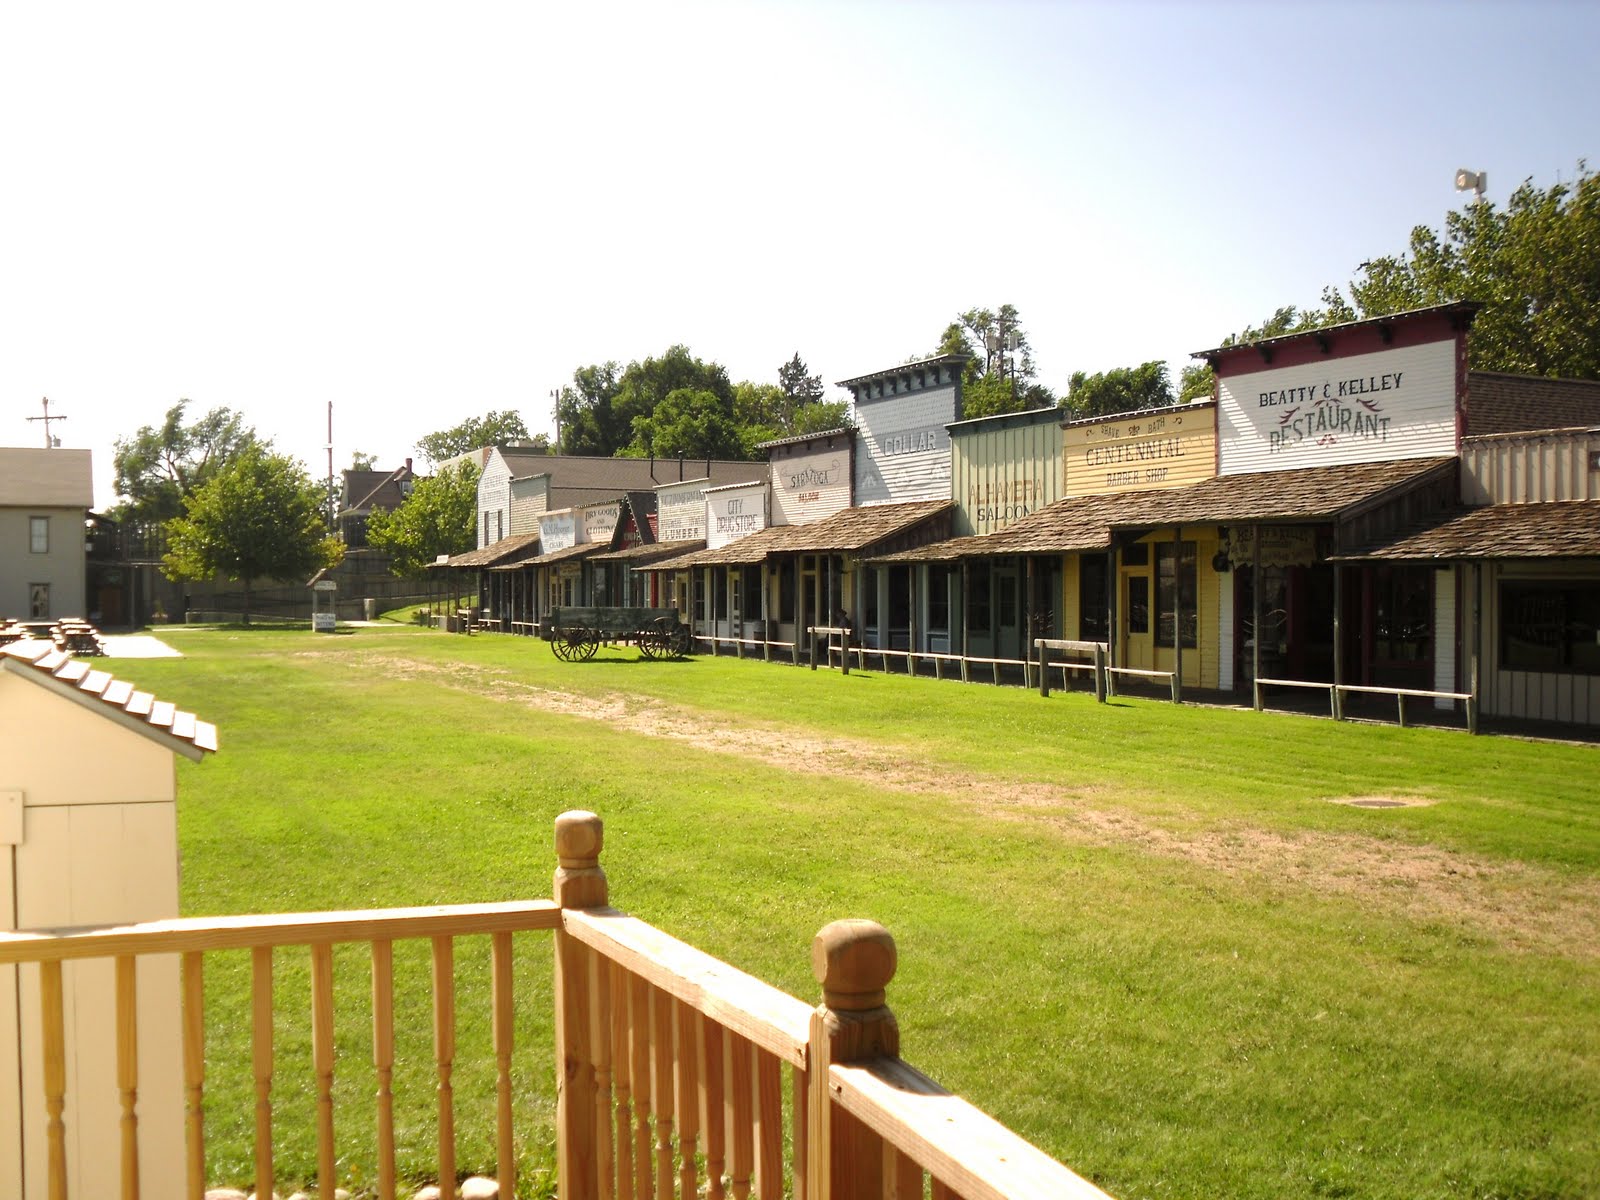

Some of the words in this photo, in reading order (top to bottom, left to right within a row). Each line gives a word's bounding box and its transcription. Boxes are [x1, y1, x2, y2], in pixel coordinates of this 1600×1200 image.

[1259, 385, 1316, 407] BEATTY
[1339, 372, 1404, 397] KELLEY
[1100, 425, 1120, 438] SHAVE
[1147, 416, 1166, 434] BATH
[1270, 404, 1391, 454] RESTAURANT
[883, 430, 937, 458] COLLAR
[1085, 437, 1185, 467] CENTENNIAL
[790, 469, 829, 488] SARATOGA
[1106, 470, 1140, 487] BARBER
[1145, 467, 1169, 482] SHOP
[968, 478, 1044, 505] ALHAMBRA
[585, 510, 597, 522] DRY
[597, 507, 618, 519] GOODS
[727, 498, 743, 515] CITY
[977, 504, 1035, 522] SALOON
[664, 527, 699, 539] LUMBER
[716, 515, 734, 533] DRUG
[735, 513, 758, 532] STORE
